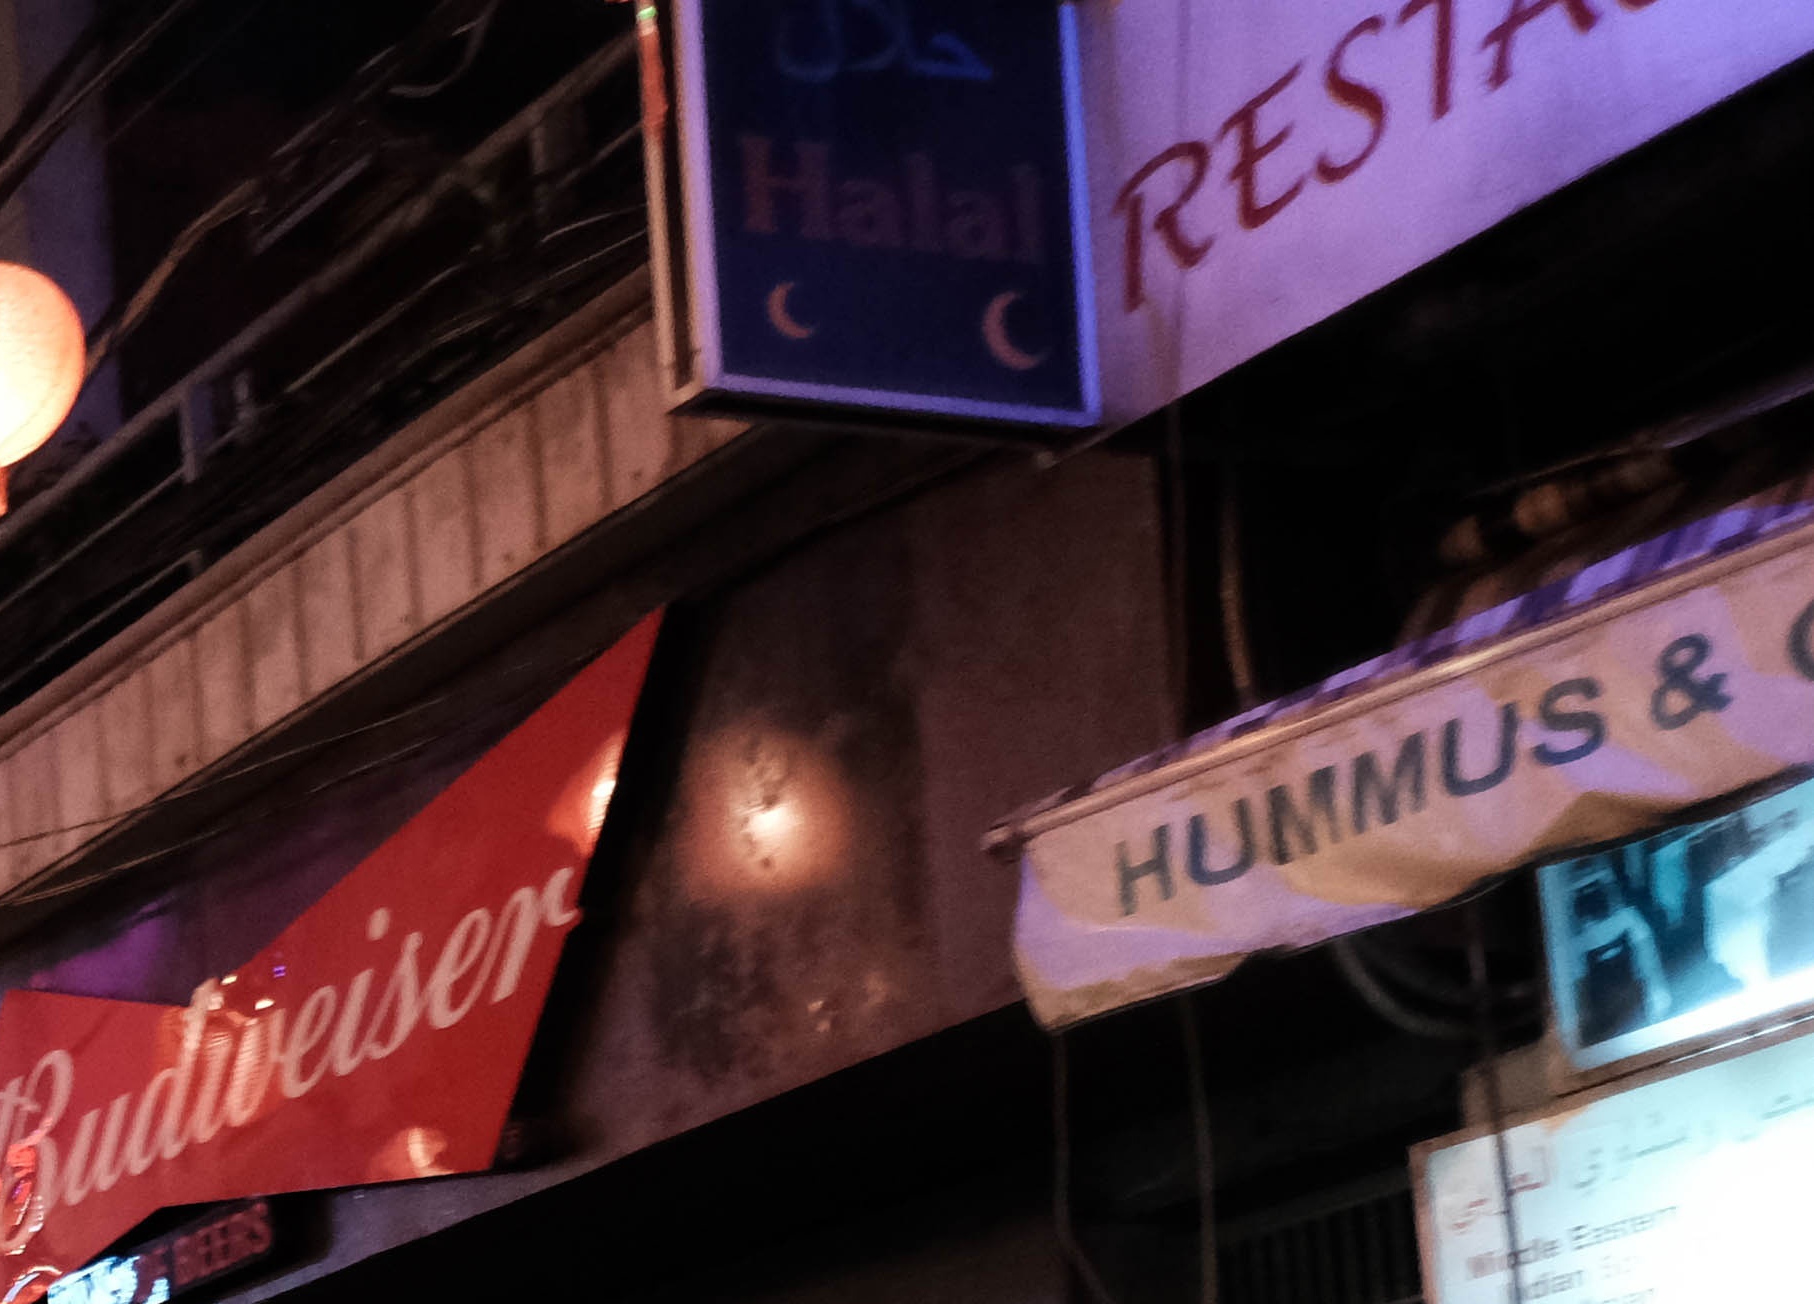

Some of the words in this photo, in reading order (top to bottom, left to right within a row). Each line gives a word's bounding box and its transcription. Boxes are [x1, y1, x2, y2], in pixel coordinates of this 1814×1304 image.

[738, 133, 1048, 266] Halal
[1110, 0, 1658, 313] RESTA
[1114, 676, 1610, 917] HUMMUS
[1649, 631, 1734, 731] &
